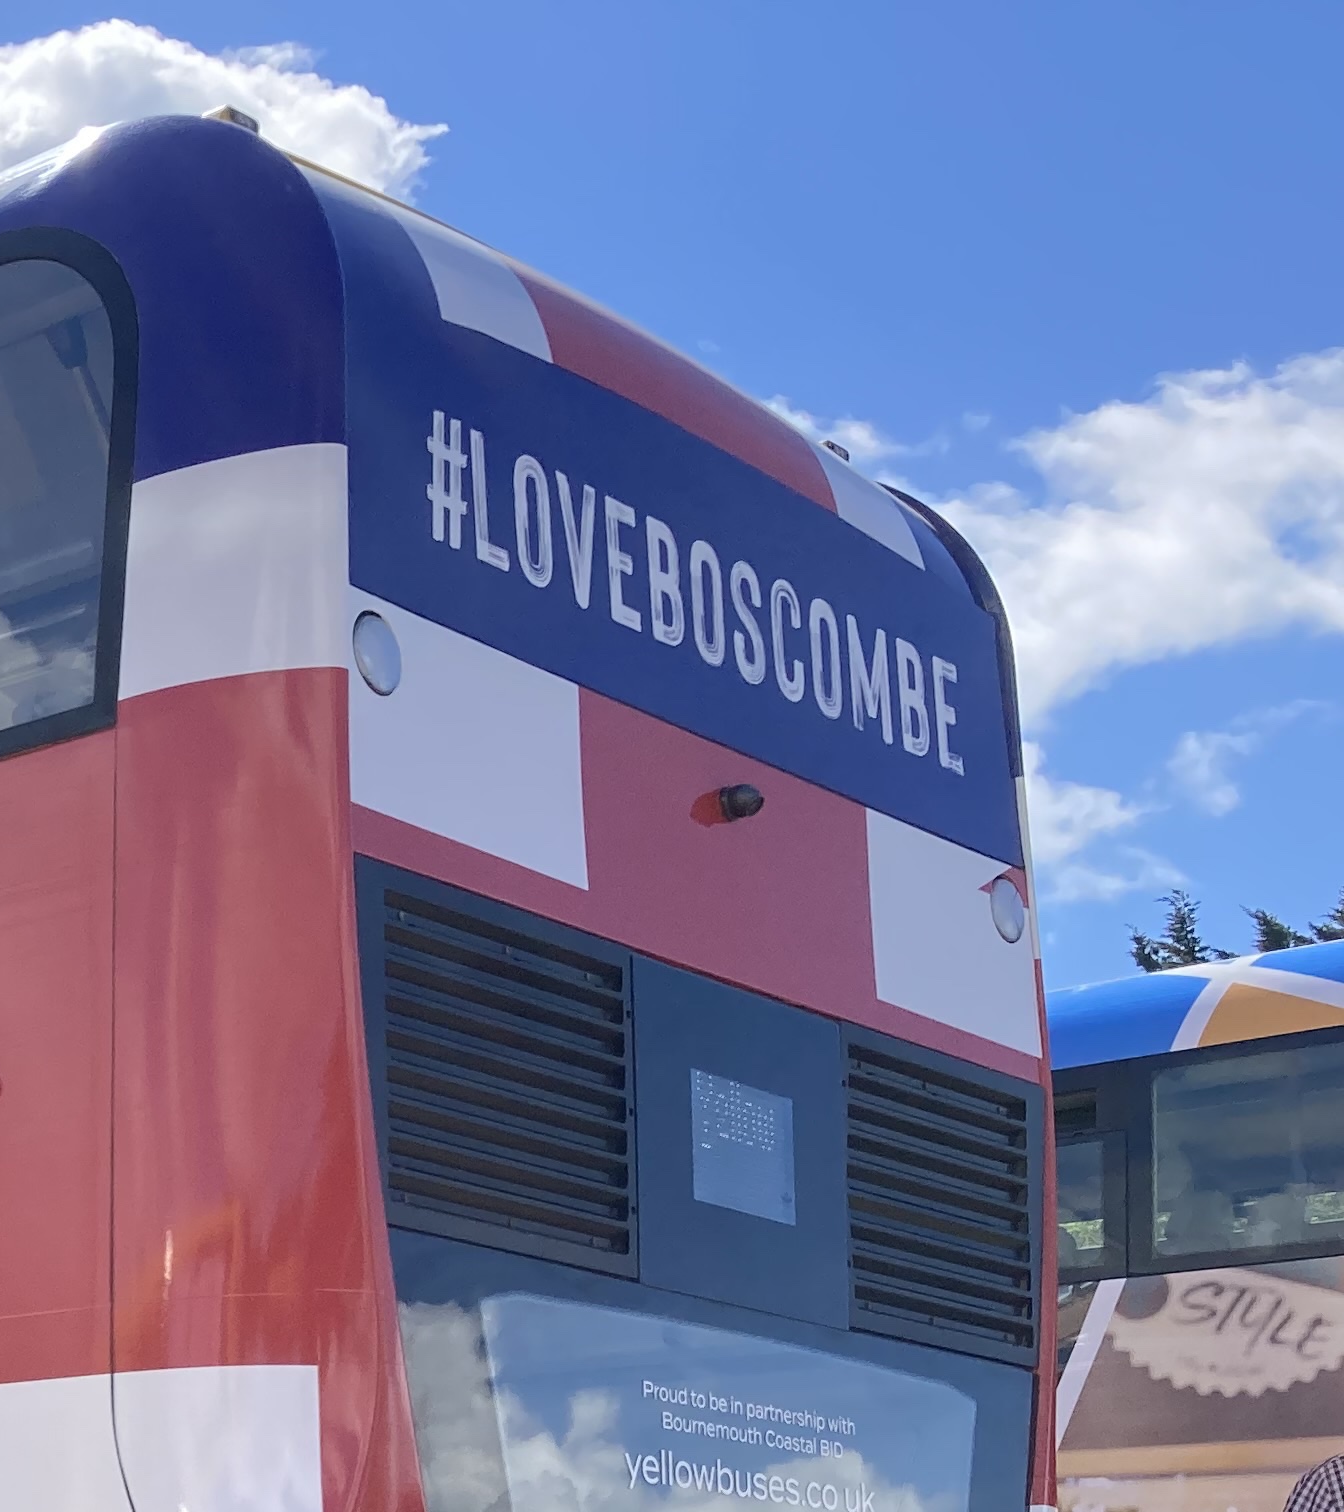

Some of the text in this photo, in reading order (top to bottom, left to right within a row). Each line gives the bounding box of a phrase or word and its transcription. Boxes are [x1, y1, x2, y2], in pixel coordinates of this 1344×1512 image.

[427, 409, 965, 777] #LOVEBOSCOMBE
[642, 1380, 856, 1436] Proud to be in partnership with
[662, 1411, 844, 1459] Bournemouth Coastal BID
